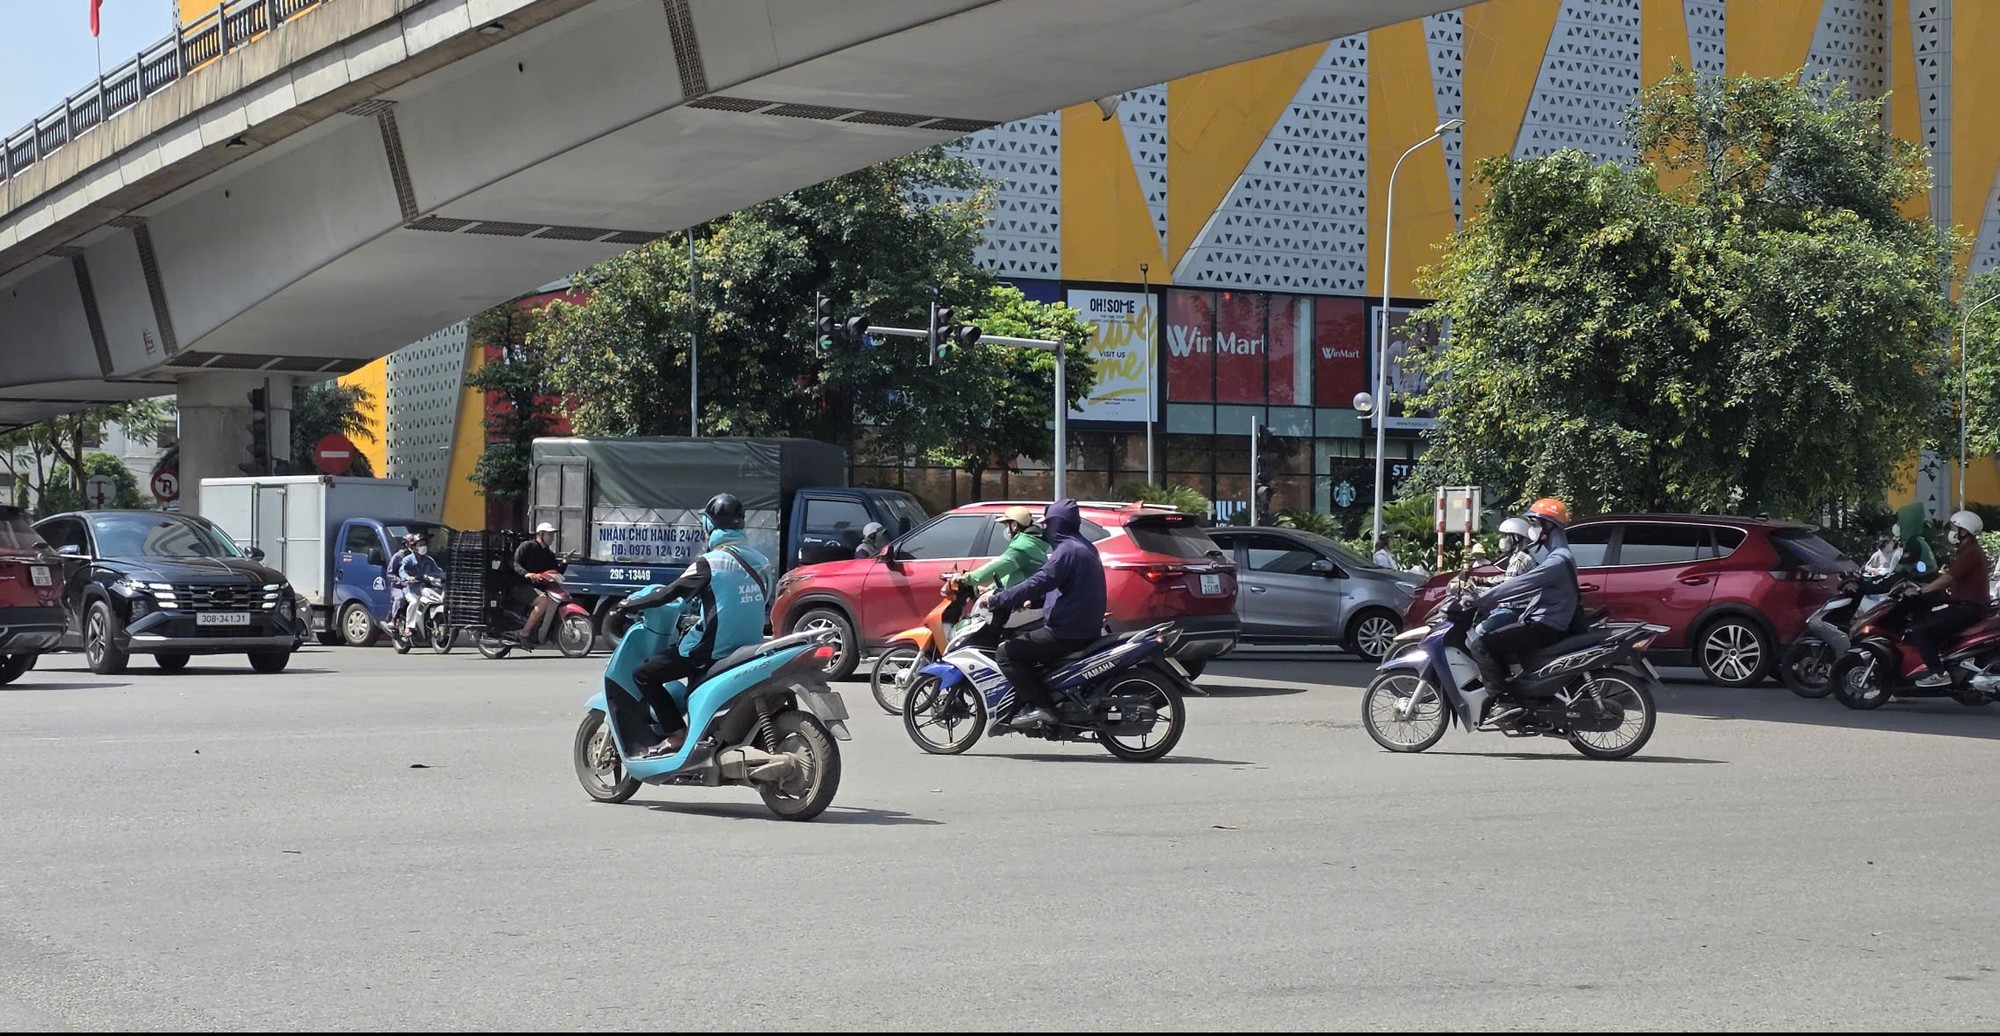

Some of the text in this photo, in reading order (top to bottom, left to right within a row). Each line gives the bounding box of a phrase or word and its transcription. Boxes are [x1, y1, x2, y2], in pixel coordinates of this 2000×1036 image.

[1090, 298, 1135, 314] OH!SOME
[1322, 347, 1360, 359] WinMart
[679, 530, 707, 543] 24/24
[629, 545, 652, 556] 0976
[656, 545, 673, 557] 124
[675, 546, 691, 558] 241
[738, 585, 760, 594] XAN
[1081, 661, 1116, 680] YAMAHA
